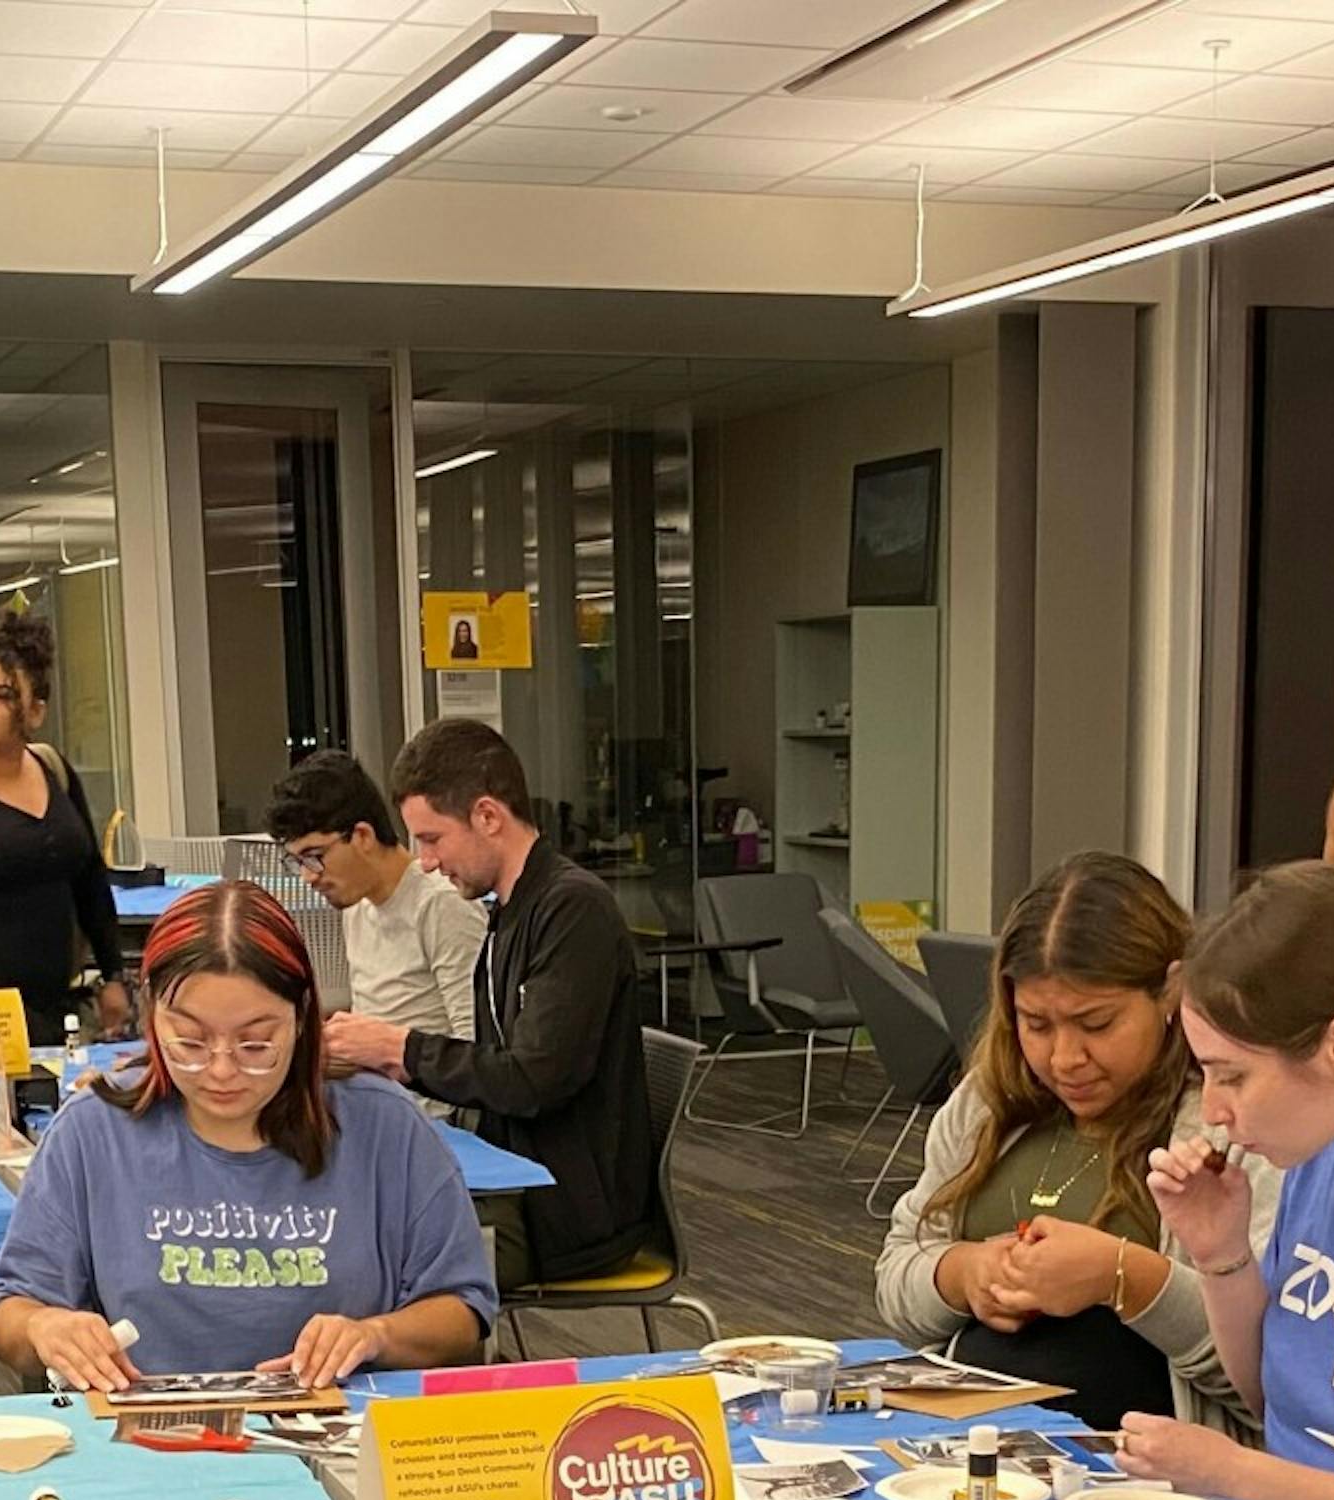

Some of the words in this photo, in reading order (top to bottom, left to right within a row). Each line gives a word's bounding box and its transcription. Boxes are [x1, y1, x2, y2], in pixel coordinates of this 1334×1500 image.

[159, 1244, 328, 1287] PLEASE
[456, 1433, 500, 1445] promotes
[393, 1454, 436, 1464] inclusion
[439, 1452, 456, 1461] and
[458, 1447, 508, 1460] expression
[511, 1446, 520, 1455] to
[522, 1443, 546, 1454] build
[404, 1470, 436, 1481] strong
[436, 1468, 455, 1478] Sun
[457, 1466, 481, 1477] Devil
[483, 1461, 536, 1474] Community
[558, 1451, 692, 1490] Culture
[398, 1487, 442, 1498] reflective
[444, 1485, 454, 1494] of
